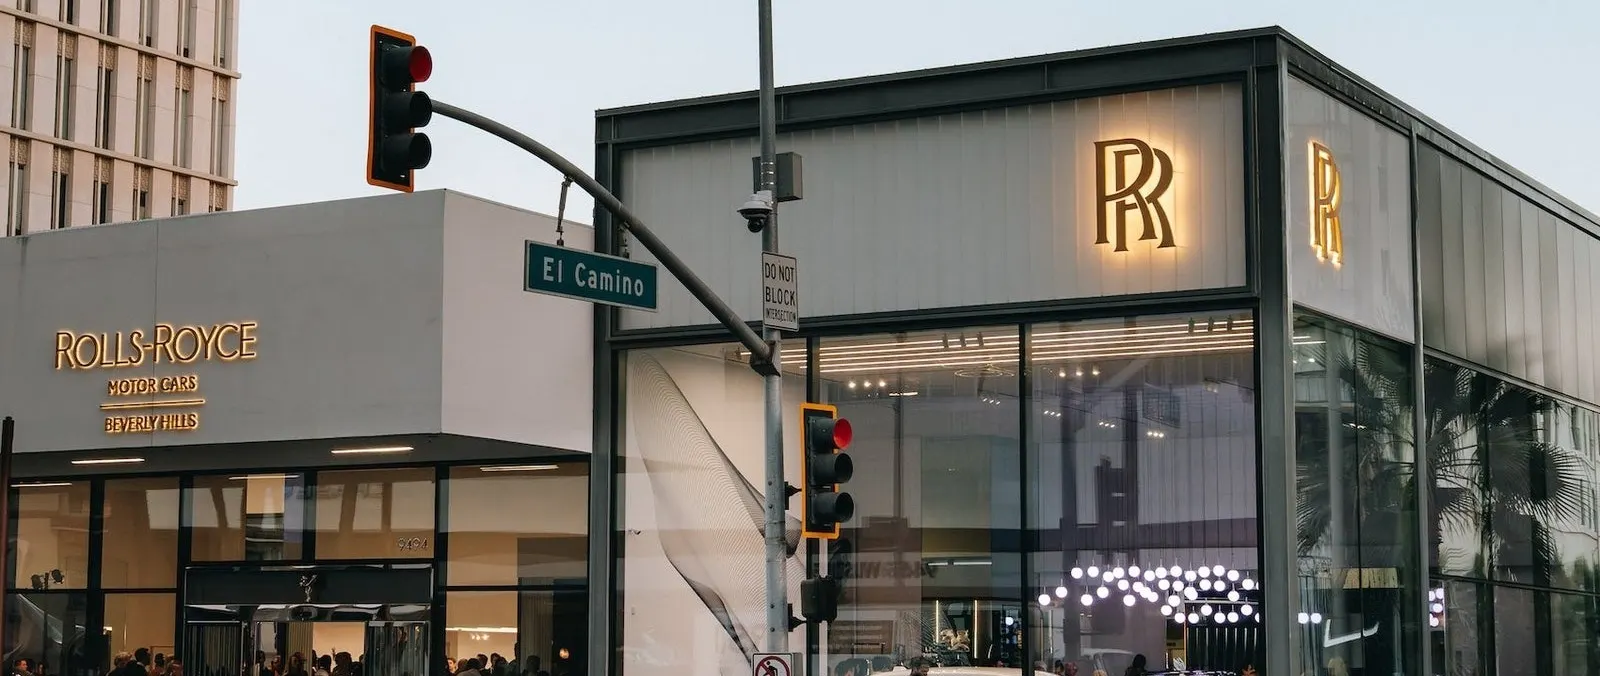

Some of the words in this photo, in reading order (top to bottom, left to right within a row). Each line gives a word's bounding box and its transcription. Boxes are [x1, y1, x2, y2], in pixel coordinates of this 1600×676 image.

[1094, 138, 1176, 252] RR
[543, 256, 562, 283] El
[574, 262, 644, 297] Camino
[765, 262, 777, 280] DO
[779, 265, 794, 282] NOT
[765, 286, 796, 306] BLOCK
[765, 307, 796, 323] INTERSECTION
[55, 322, 257, 369] ROLLS-ROYCE
[107, 378, 157, 395] MOTOR
[160, 375, 197, 392] CARS
[104, 415, 159, 432] BEVERLY
[160, 413, 197, 430] HILLS
